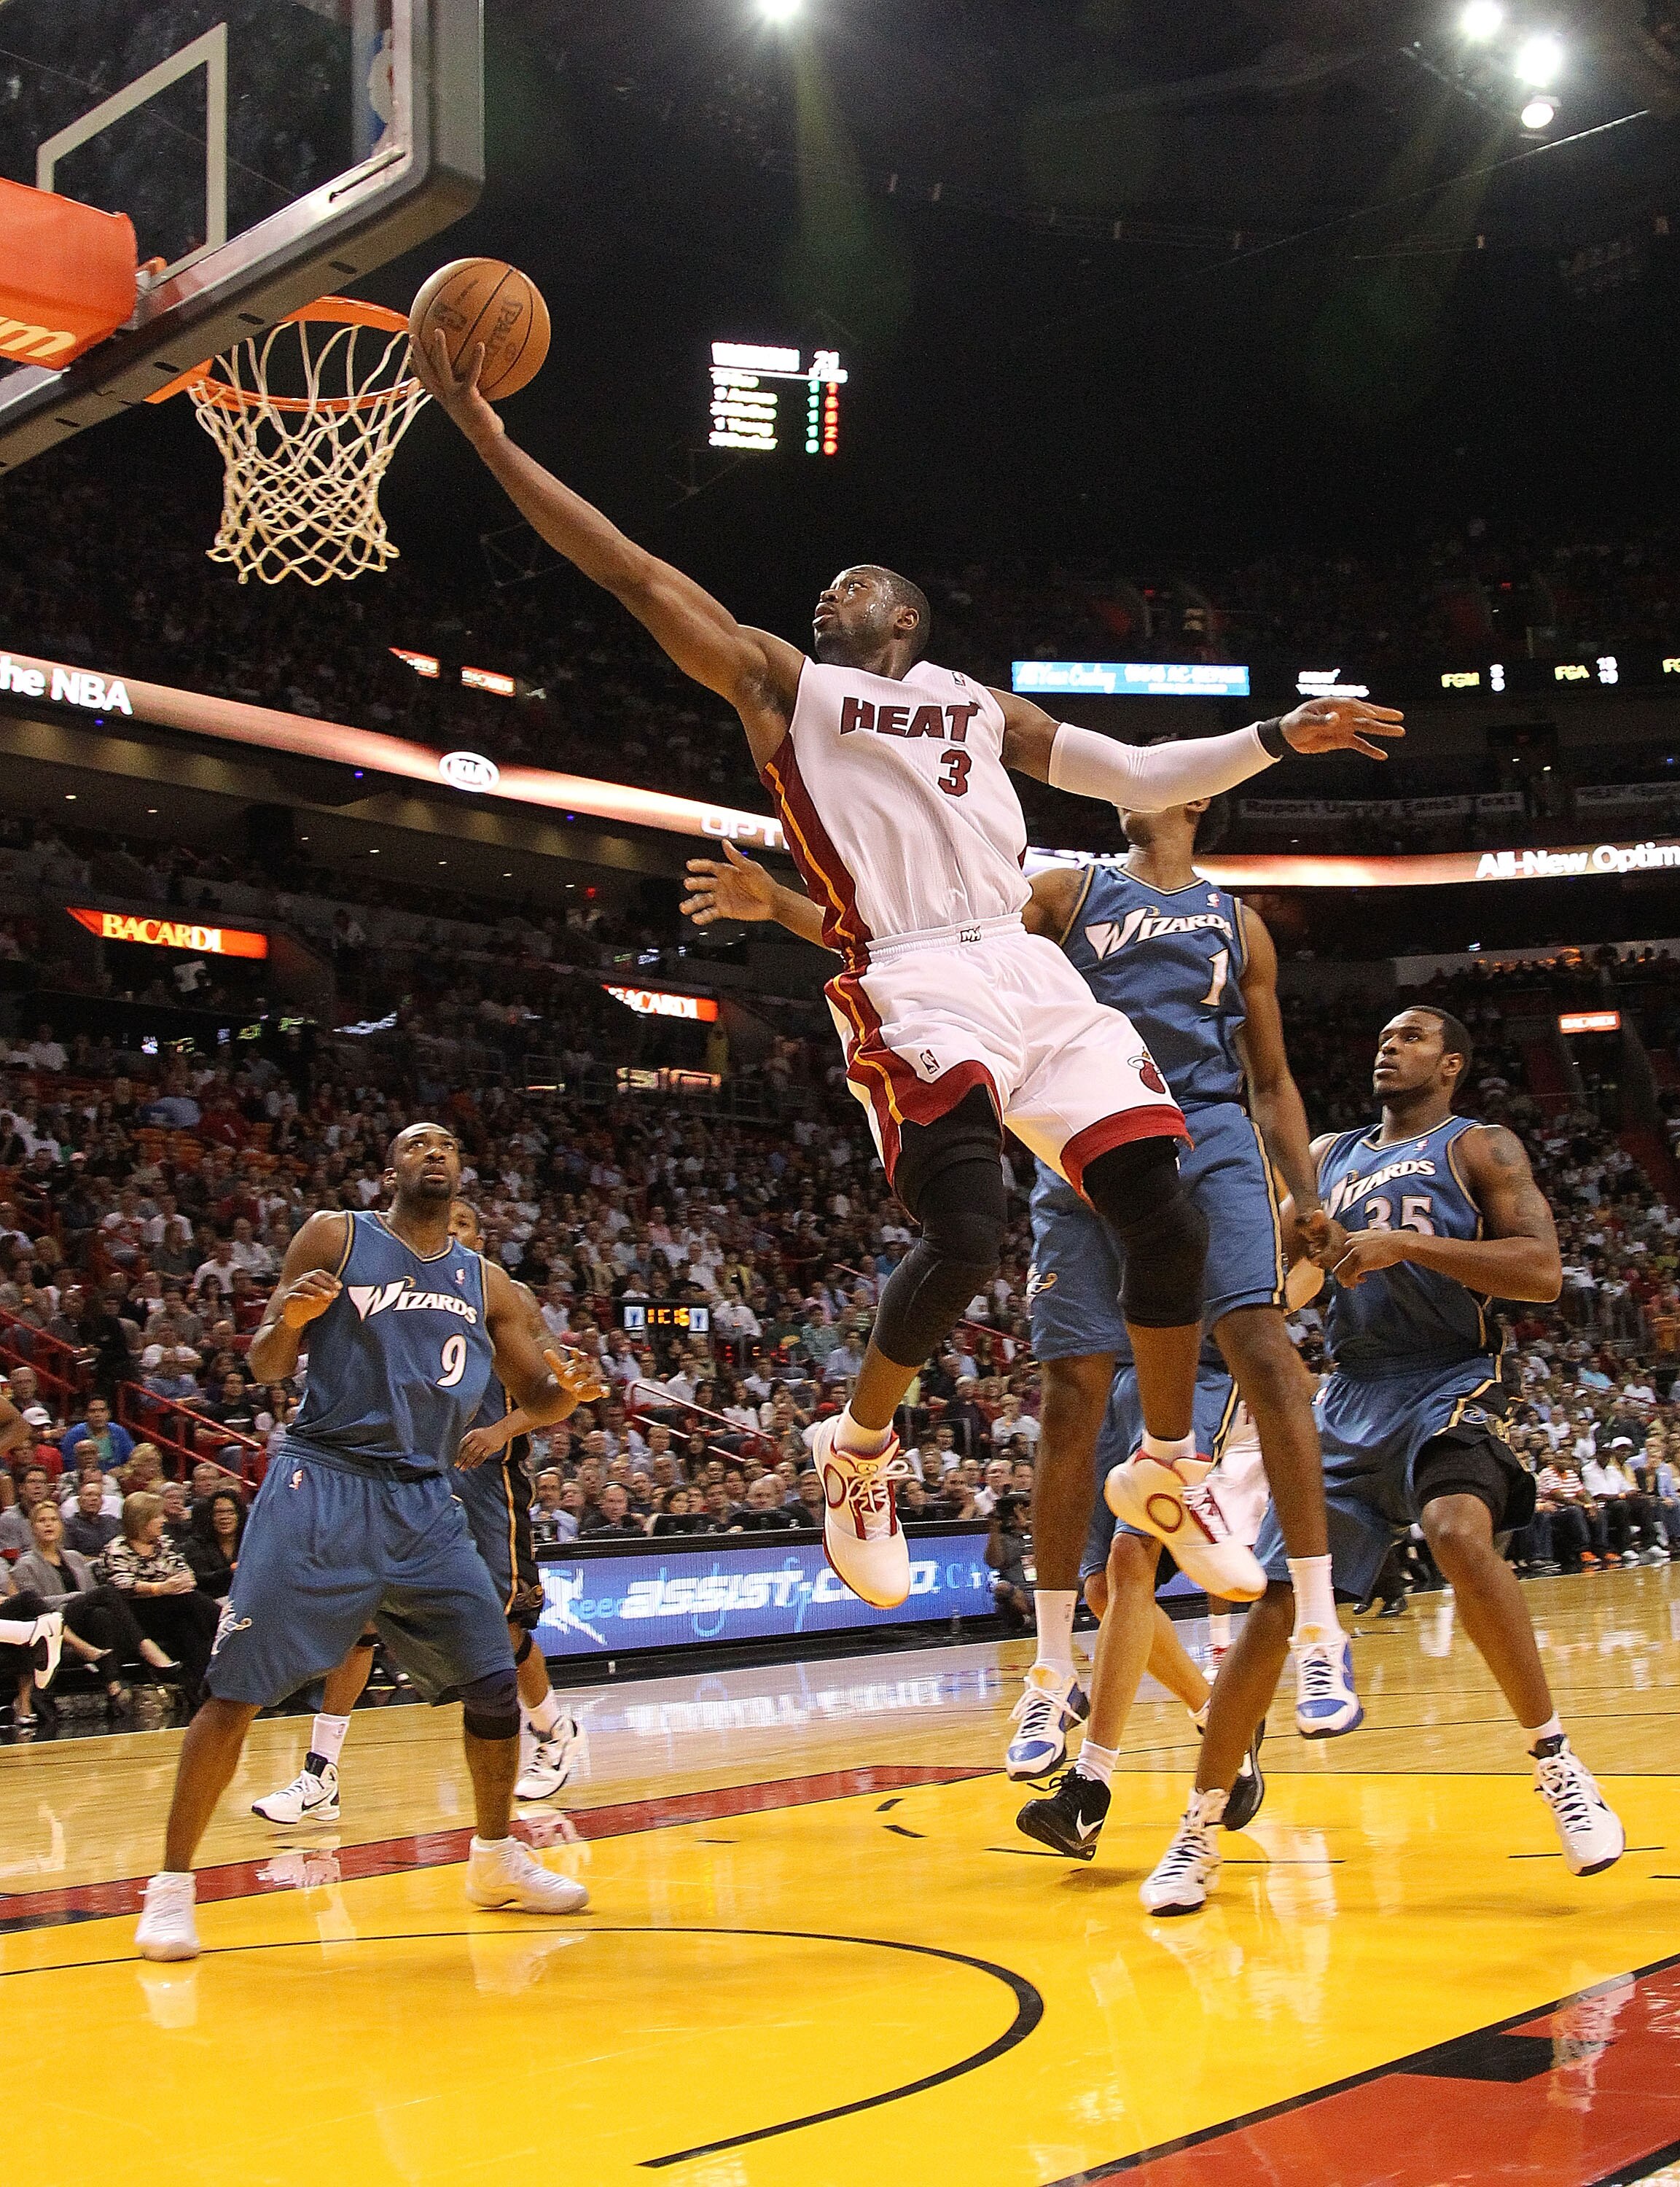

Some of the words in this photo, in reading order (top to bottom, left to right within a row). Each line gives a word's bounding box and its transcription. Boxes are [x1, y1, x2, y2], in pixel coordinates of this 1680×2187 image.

[50, 668, 133, 715] NBA
[1555, 665, 1590, 680] FGA
[840, 696, 981, 743] HEAT
[937, 749, 972, 798] 3
[1475, 849, 1588, 878] All-New
[102, 913, 225, 954] BACARDI
[1200, 948, 1229, 1006] 1
[1364, 1194, 1436, 1237] 35
[347, 1279, 478, 1323] WIZARDS
[436, 1333, 467, 1387] 9
